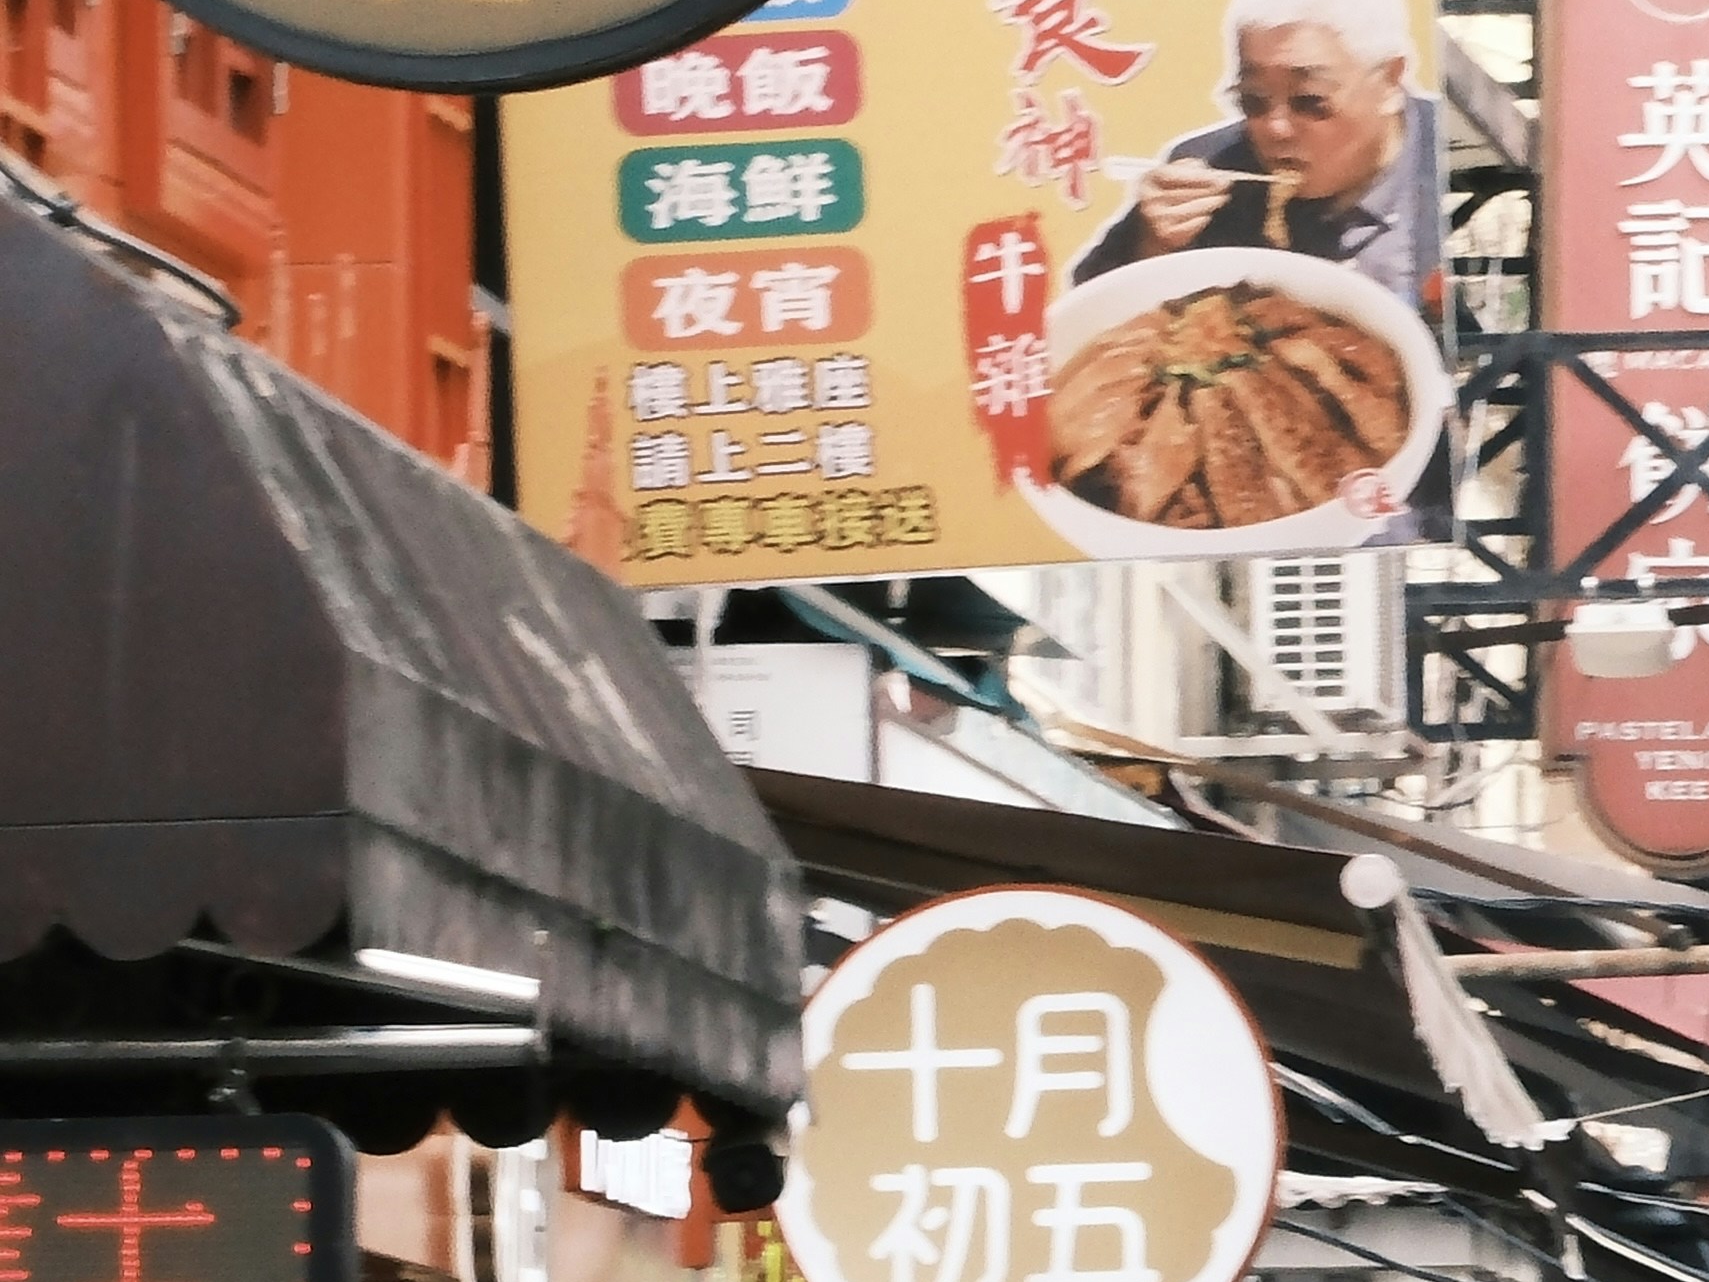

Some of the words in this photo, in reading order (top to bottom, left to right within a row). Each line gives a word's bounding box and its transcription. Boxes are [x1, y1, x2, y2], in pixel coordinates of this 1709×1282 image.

[640, 43, 838, 122] 晚飯
[644, 150, 838, 230] 海鮮
[650, 261, 842, 340] 夜宵
[843, 984, 1135, 1142] 十月
